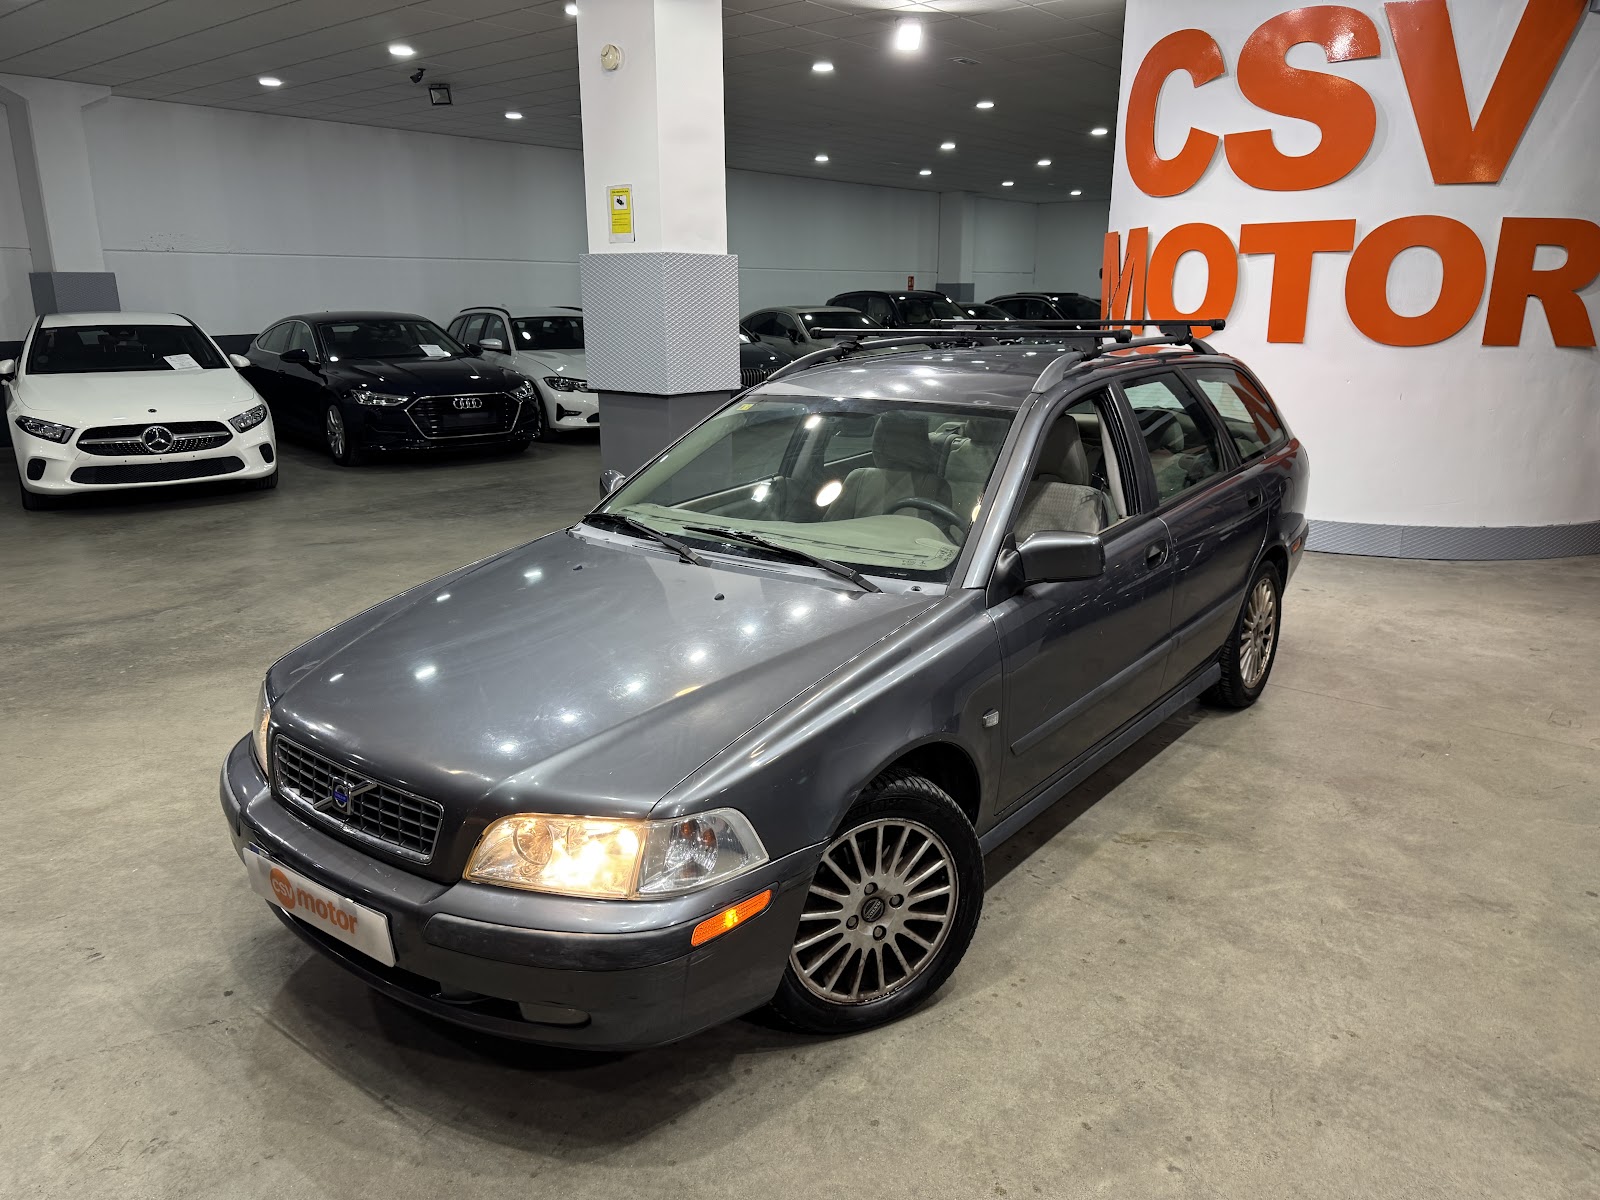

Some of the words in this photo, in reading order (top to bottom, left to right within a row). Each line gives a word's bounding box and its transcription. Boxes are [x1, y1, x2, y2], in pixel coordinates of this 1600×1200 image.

[1125, 0, 1588, 198] CSV
[1101, 215, 1600, 348] MOTOR
[297, 887, 358, 935] motor
